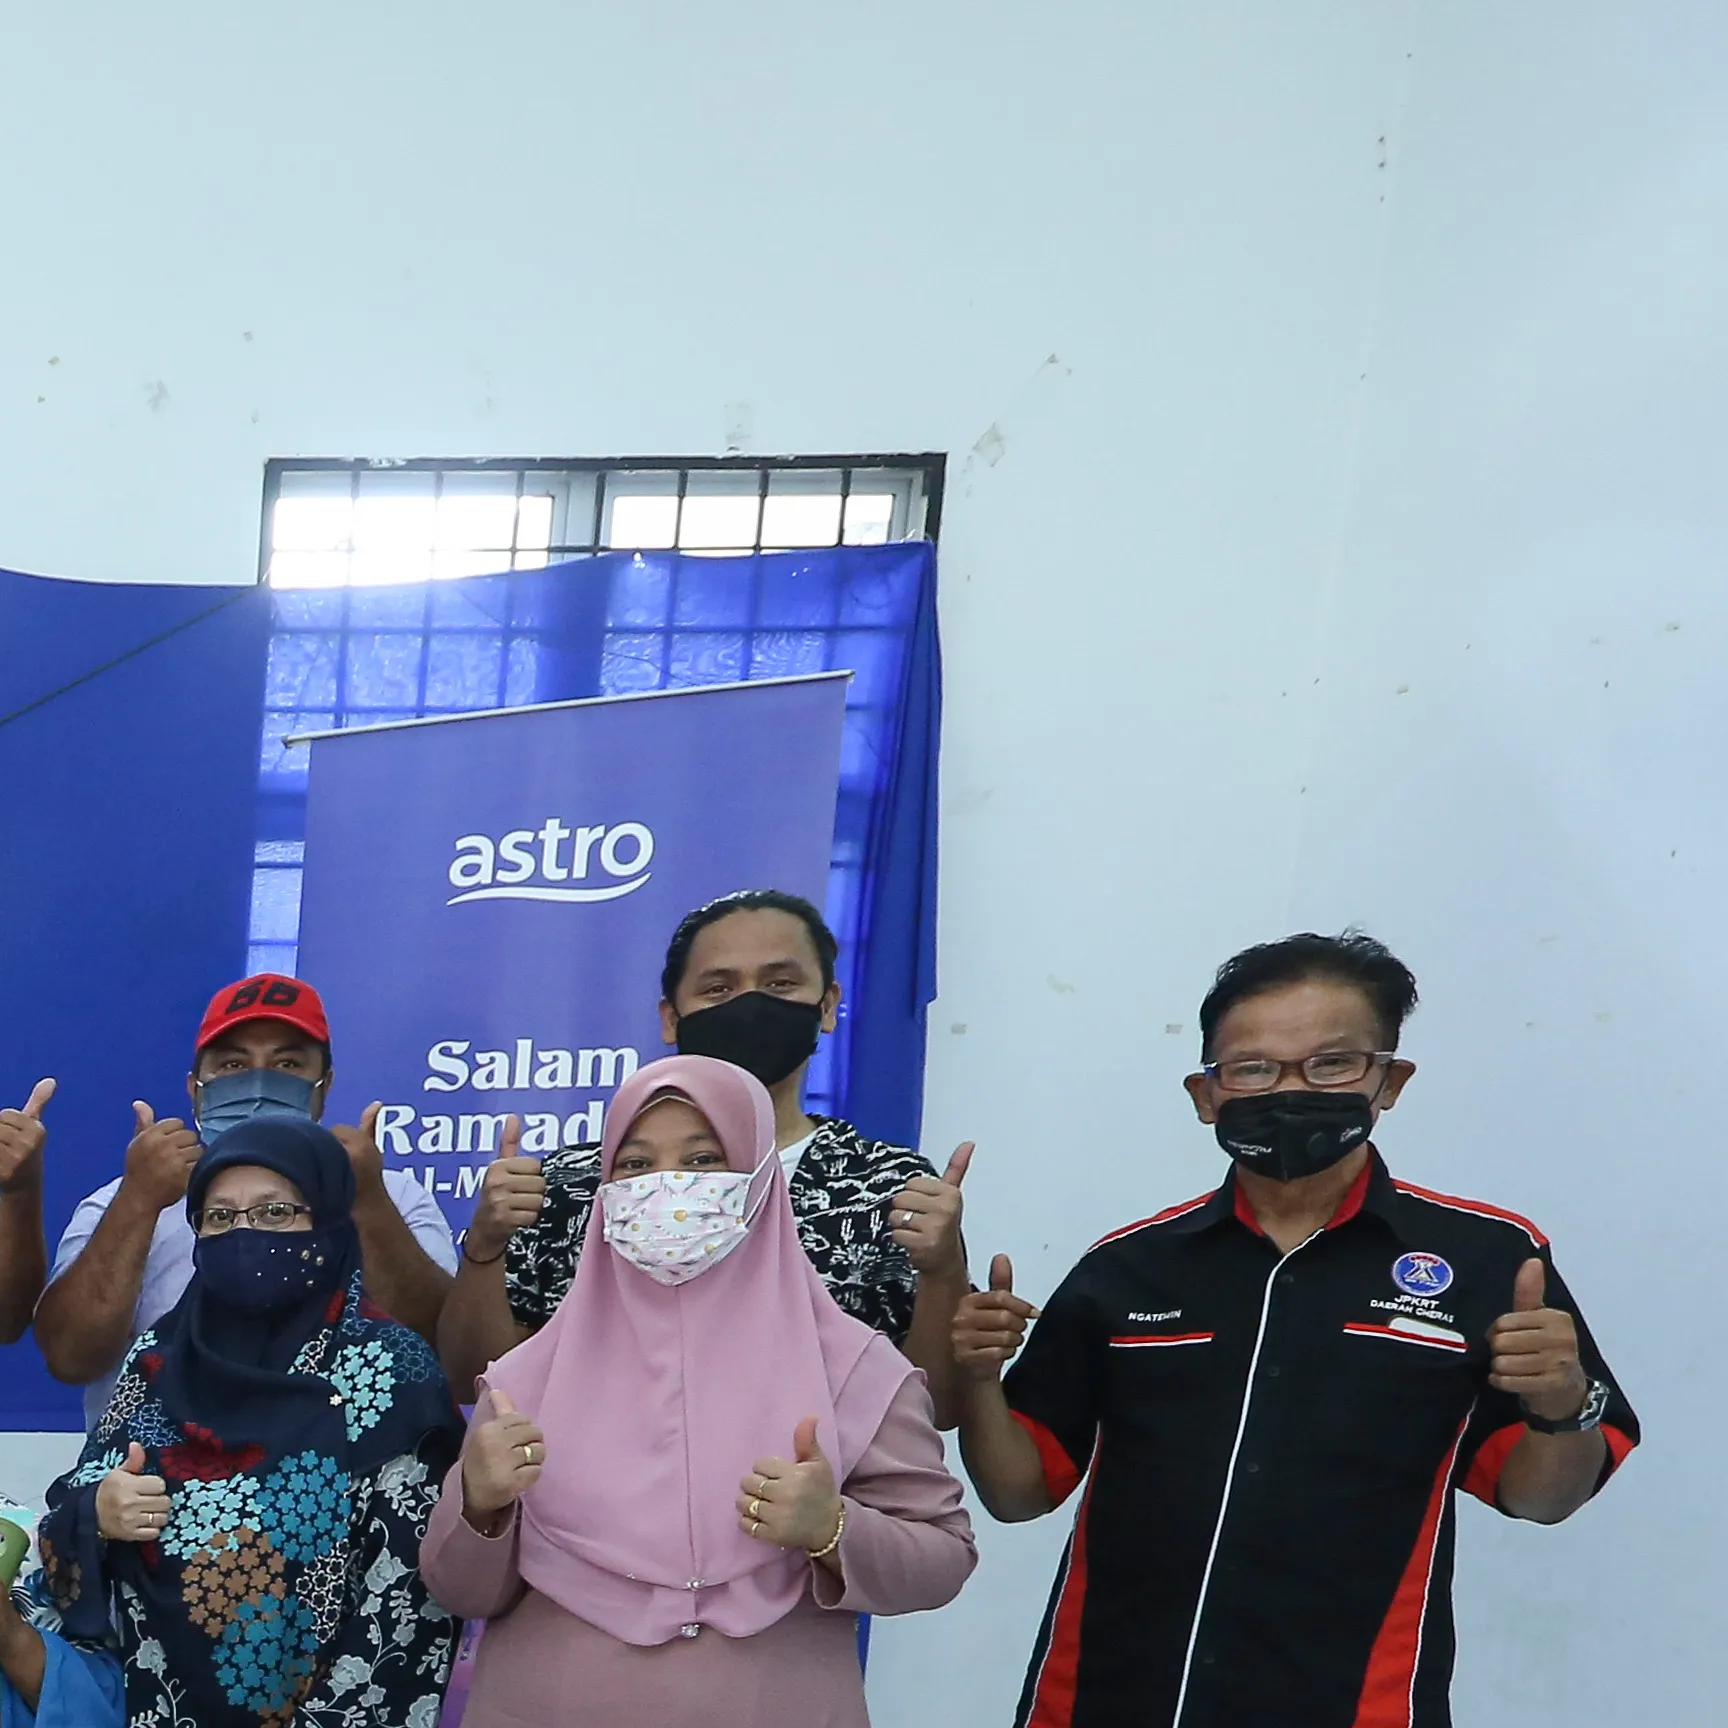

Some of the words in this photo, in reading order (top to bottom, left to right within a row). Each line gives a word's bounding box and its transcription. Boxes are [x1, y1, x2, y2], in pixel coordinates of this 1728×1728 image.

[448, 817, 655, 887] astro
[423, 1038, 640, 1093] Salam
[374, 1100, 606, 1155] Ramad
[1370, 1300, 1414, 1314] DAERAH
[1415, 1307, 1455, 1324] CHERAS
